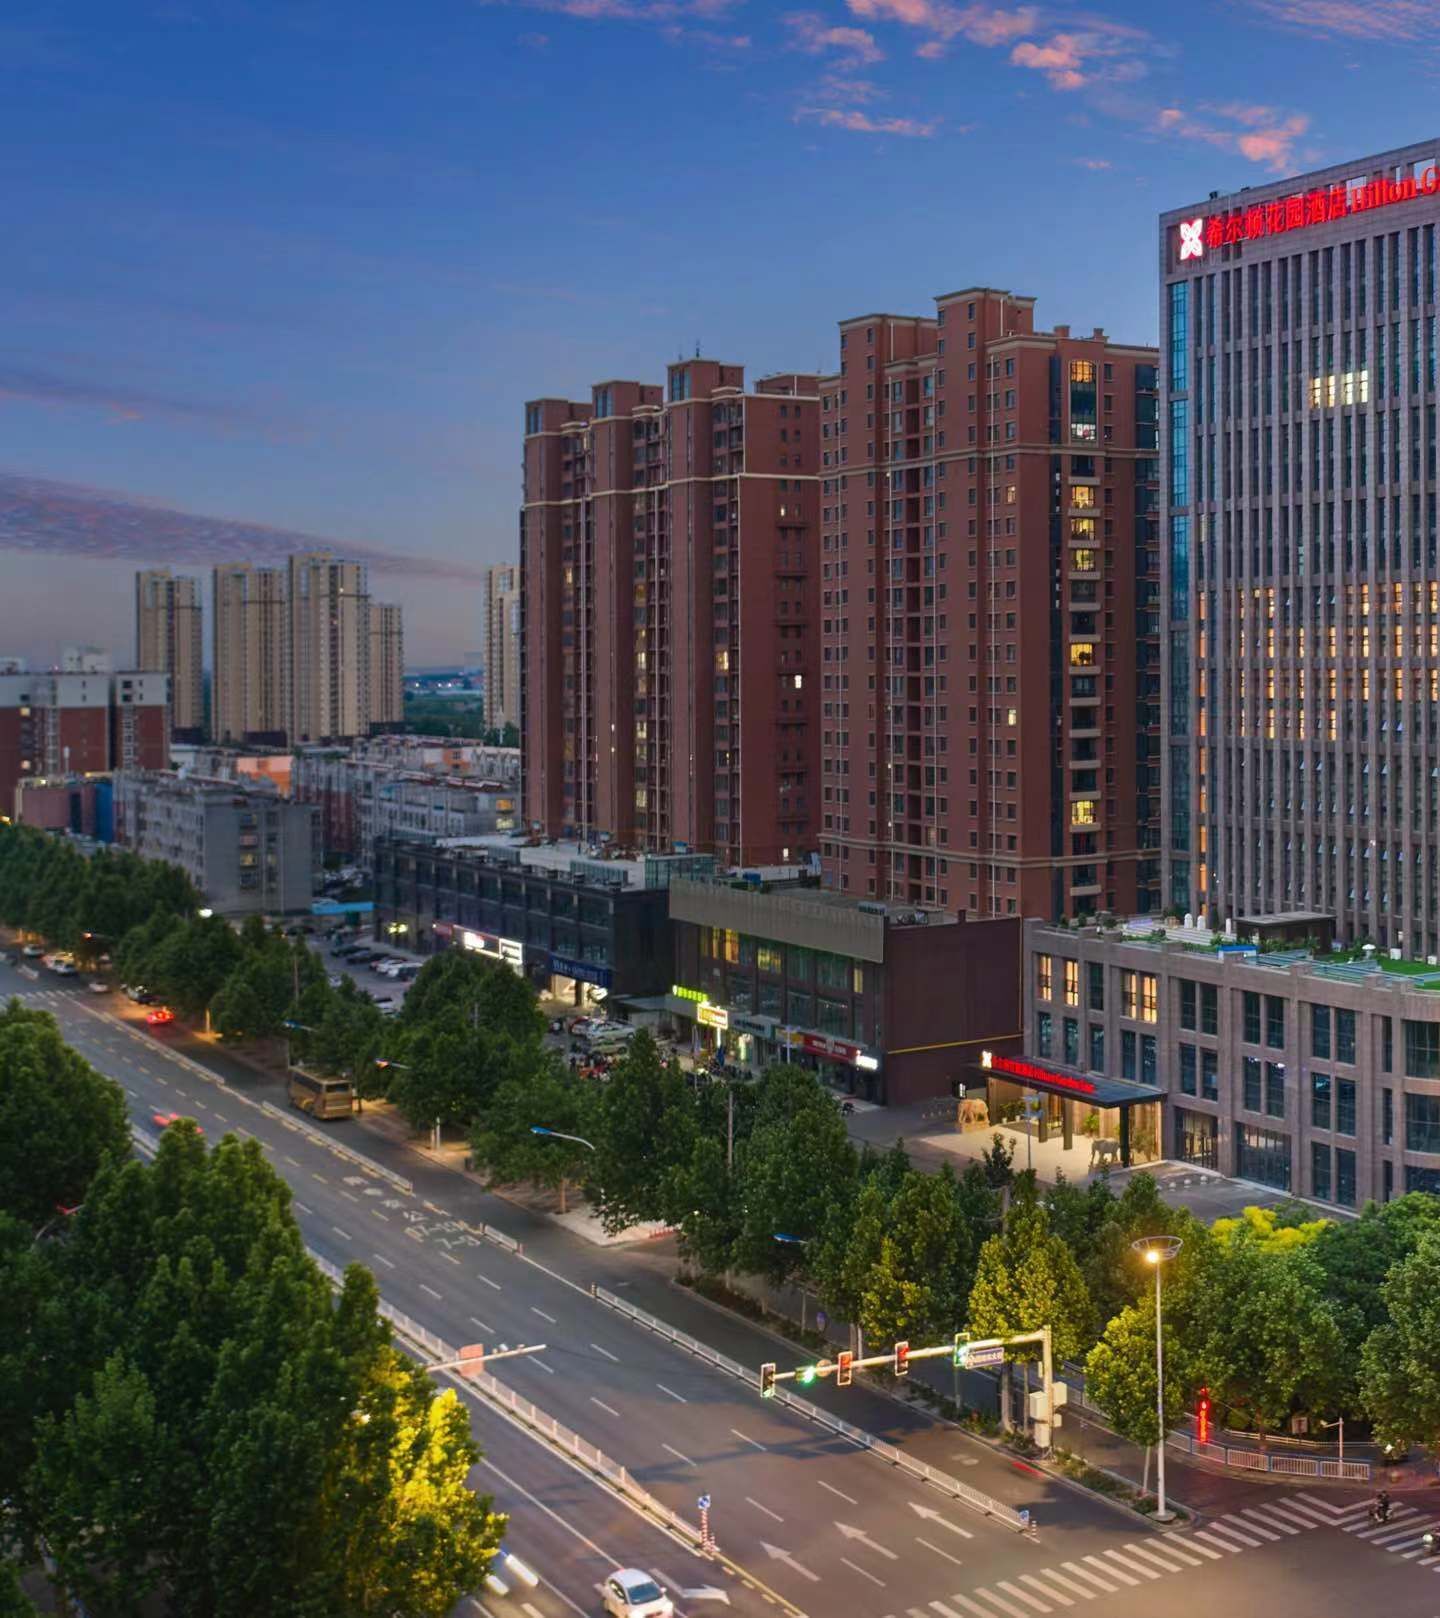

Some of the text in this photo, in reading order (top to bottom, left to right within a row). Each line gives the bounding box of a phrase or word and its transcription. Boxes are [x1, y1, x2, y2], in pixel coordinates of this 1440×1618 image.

[1206, 184, 1347, 248] 希尔顿花园酒店
[1351, 178, 1417, 213] Hilton
